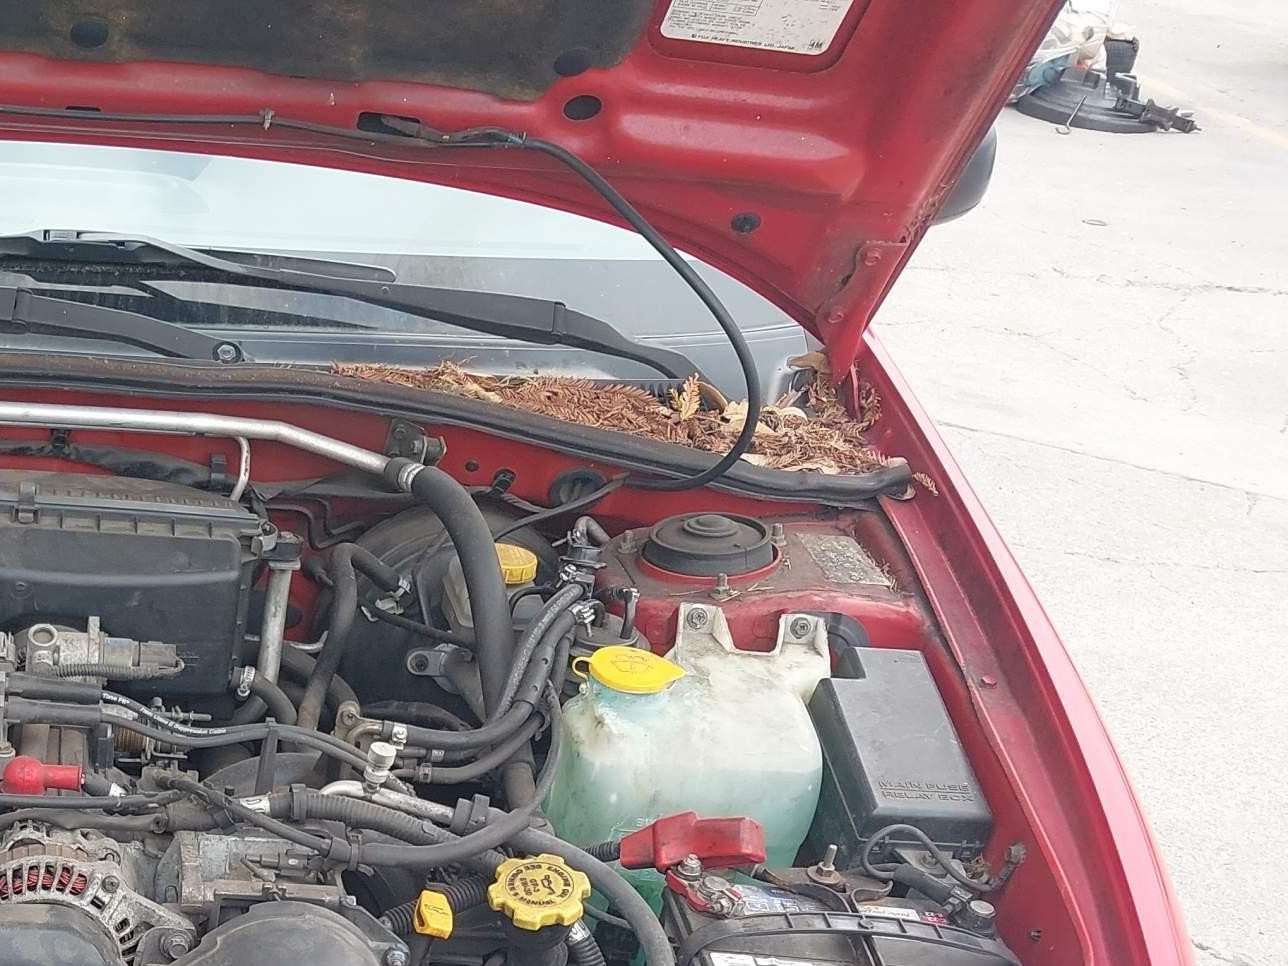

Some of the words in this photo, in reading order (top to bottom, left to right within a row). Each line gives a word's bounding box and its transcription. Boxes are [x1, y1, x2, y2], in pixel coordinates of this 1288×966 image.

[878, 779, 923, 790] MAIN
[925, 783, 969, 792] FUSE
[881, 790, 933, 801] RELAY
[937, 793, 975, 802] BOX
[546, 866, 572, 888] ENGINE
[518, 896, 557, 906] MANUAL
